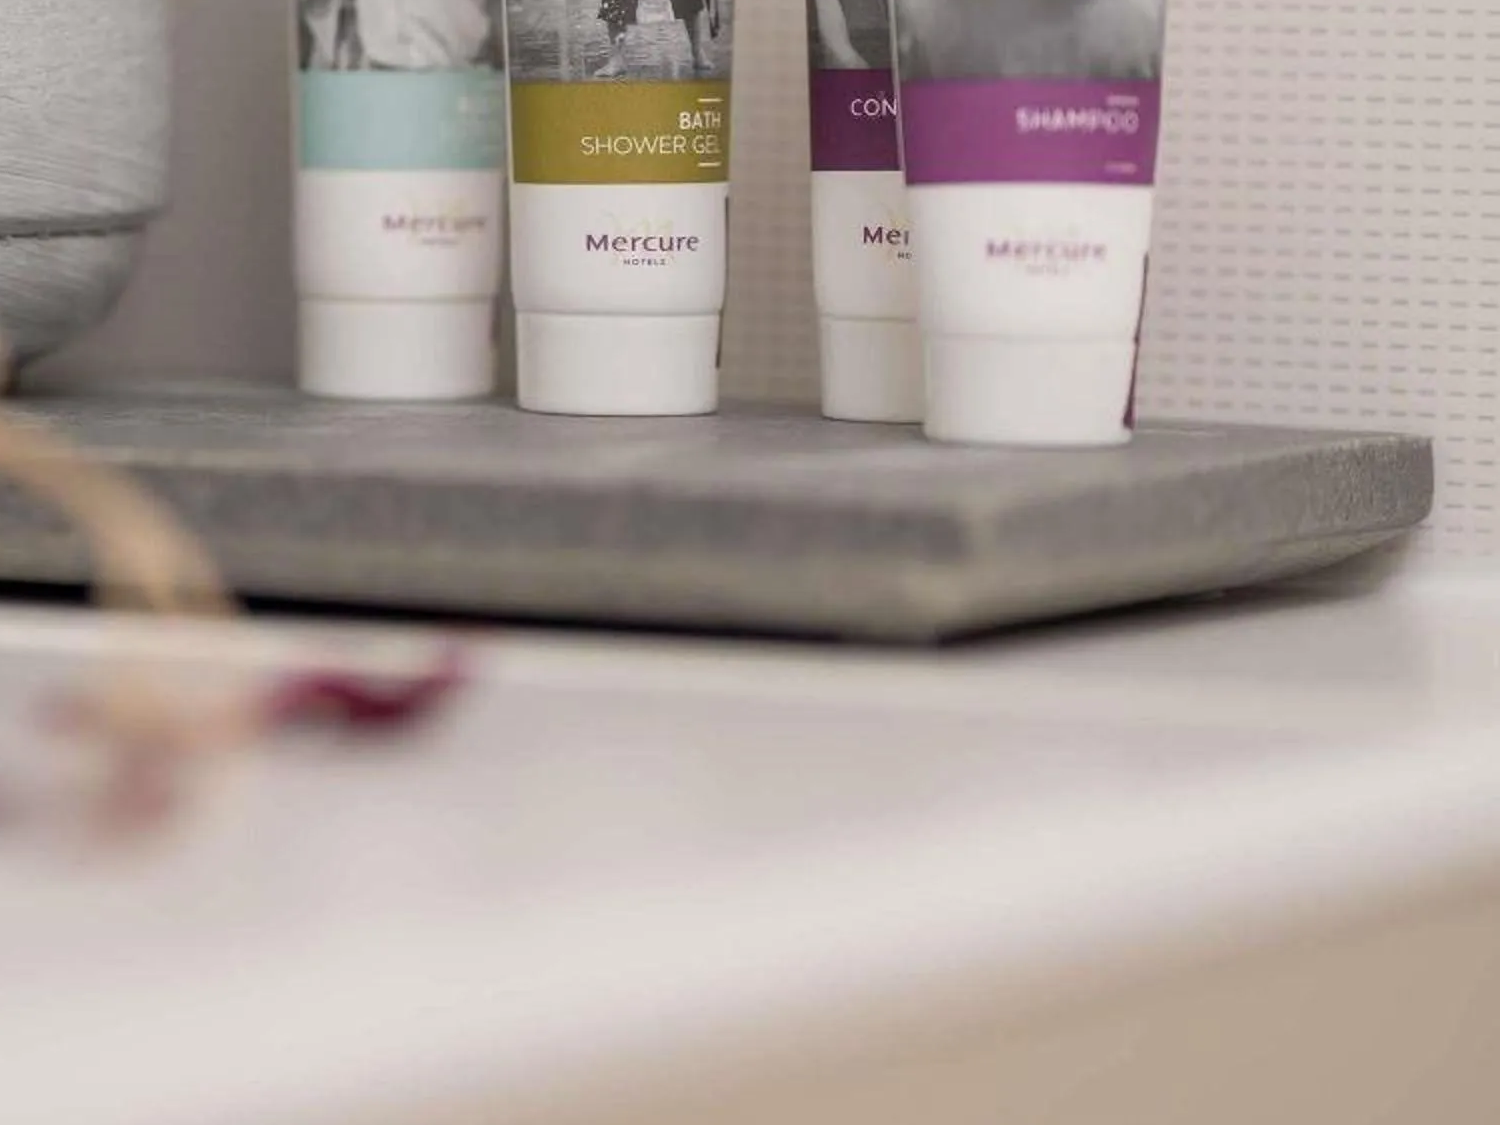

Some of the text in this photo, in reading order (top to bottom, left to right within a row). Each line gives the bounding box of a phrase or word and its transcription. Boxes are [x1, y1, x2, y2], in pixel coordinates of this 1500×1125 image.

[678, 111, 722, 130] BATH
[1015, 107, 1140, 135] SHAMPOO
[580, 134, 722, 156] SHOWER GEL
[585, 234, 700, 252] Mercure
[622, 258, 667, 267] HOTELS
